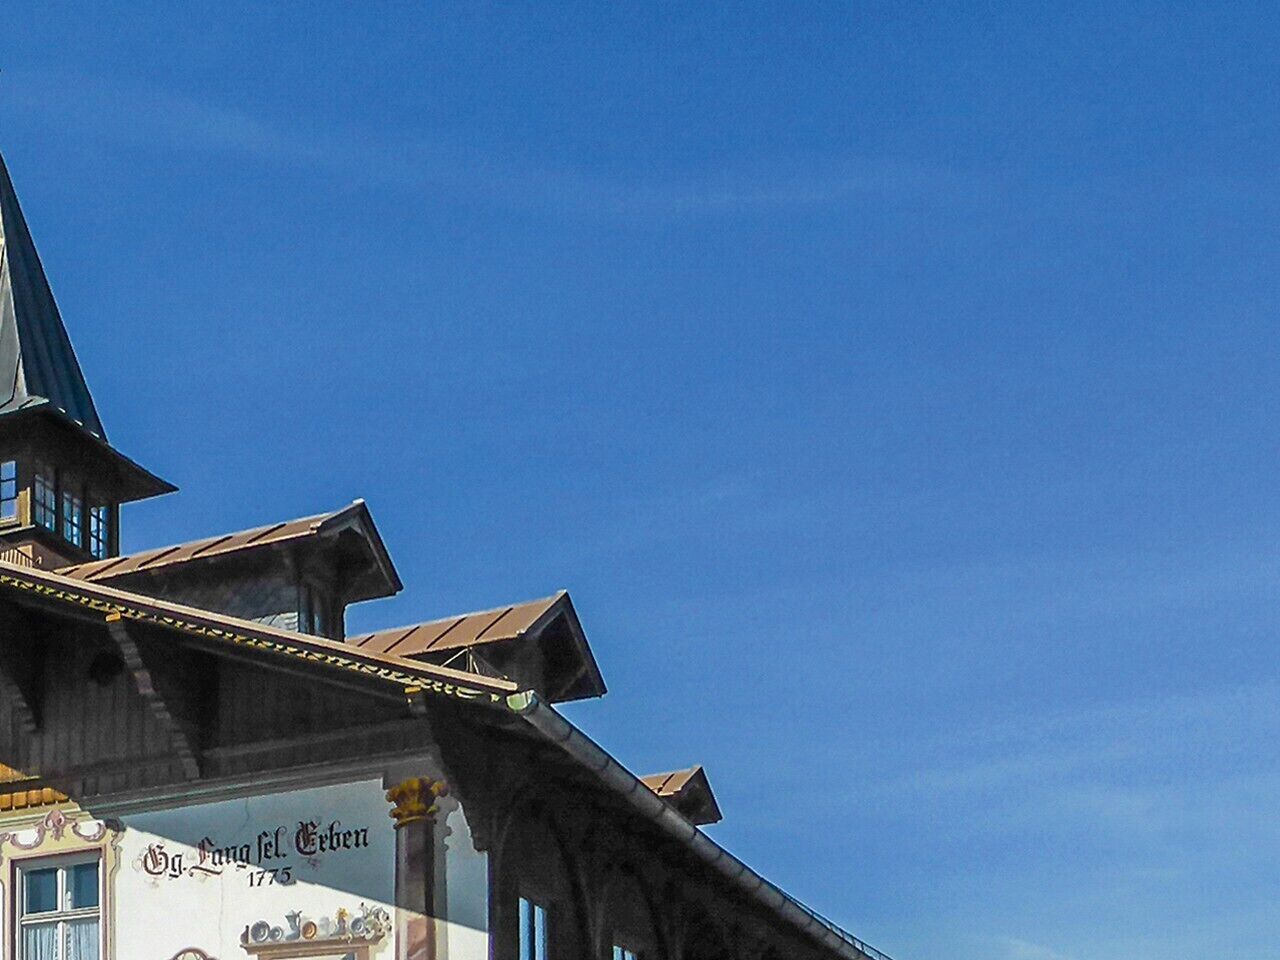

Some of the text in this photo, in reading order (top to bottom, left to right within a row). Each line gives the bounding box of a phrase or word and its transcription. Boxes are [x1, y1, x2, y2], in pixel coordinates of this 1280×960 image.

[143, 842, 187, 878] Gg.
[189, 836, 249, 877] Lang
[295, 820, 369, 857] Erben
[247, 866, 291, 888] 1775
